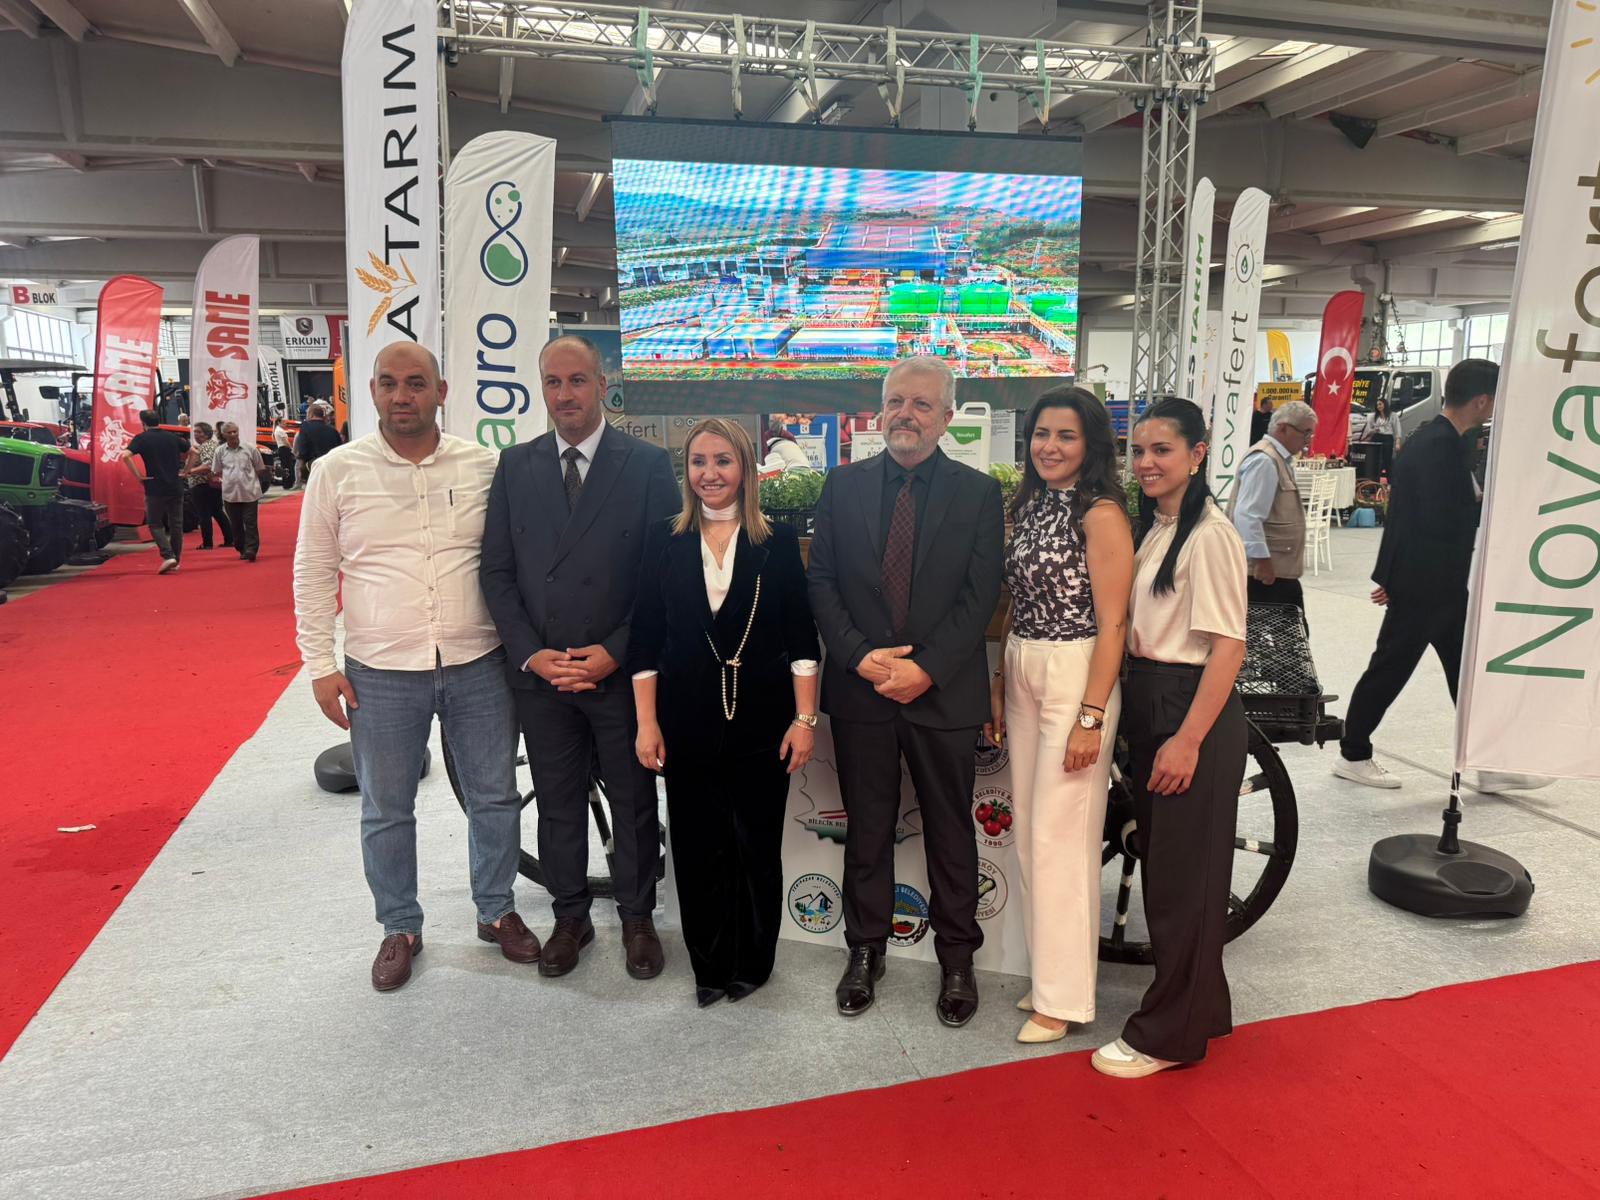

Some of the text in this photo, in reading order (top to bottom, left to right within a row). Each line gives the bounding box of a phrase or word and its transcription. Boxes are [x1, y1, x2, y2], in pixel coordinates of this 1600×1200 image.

[12, 286, 56, 304] B BLOK
[205, 290, 251, 361] SAME
[103, 334, 153, 411] SAME
[285, 336, 328, 346] ERKUNT
[476, 313, 530, 450] agro
[1215, 310, 1249, 504] Novafert
